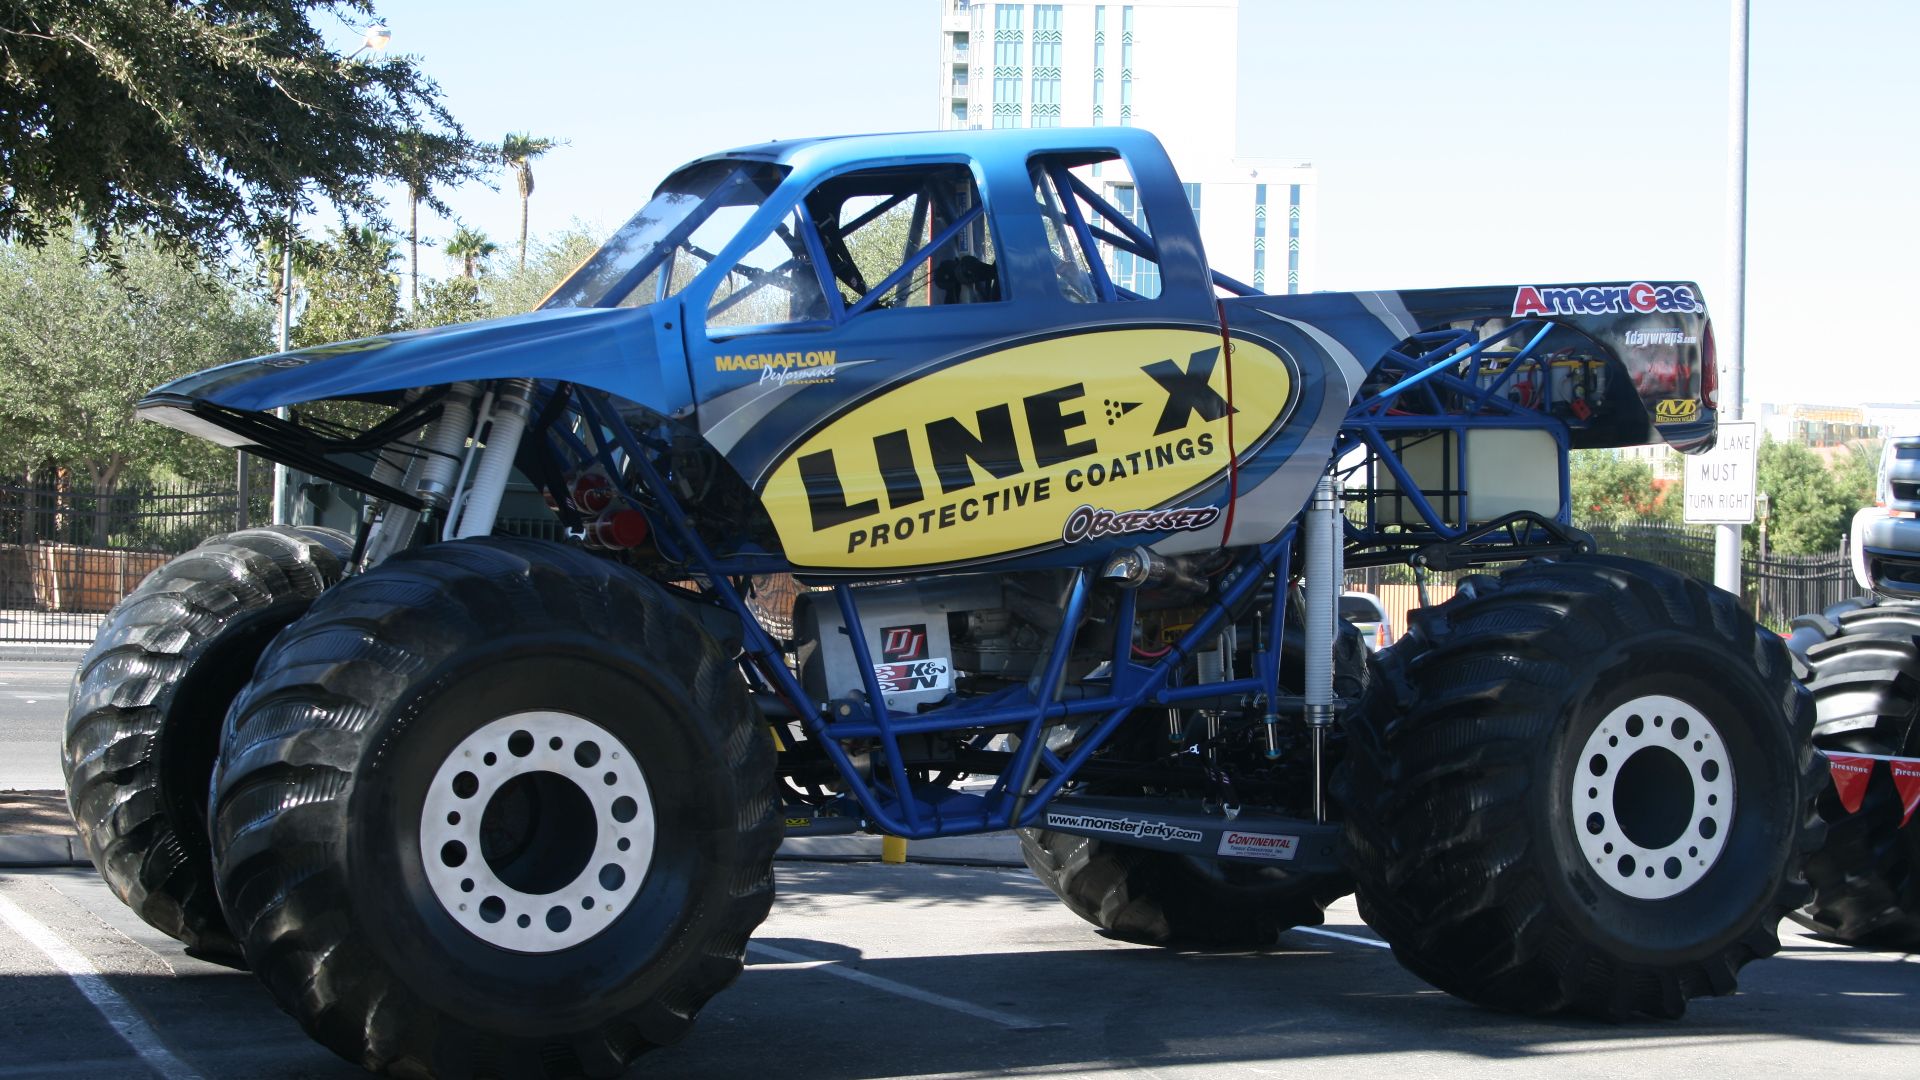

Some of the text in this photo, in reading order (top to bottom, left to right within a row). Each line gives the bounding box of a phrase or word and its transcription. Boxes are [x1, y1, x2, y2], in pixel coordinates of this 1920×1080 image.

[1512, 282, 1698, 317] AmeriGas
[715, 351, 836, 372] MAGNAFLOW
[760, 364, 836, 387] Performance
[1724, 435, 1751, 451] LANE
[1702, 464, 1738, 481] MUST
[847, 433, 1214, 554] PROTECTIVE COATINGS
[1689, 494, 1749, 509] TURN RIGHT
[1830, 761, 1869, 774] Firestone
[1049, 815, 1201, 841] www.monsterjerky.com
[1228, 833, 1290, 849] CONTINENTAL
